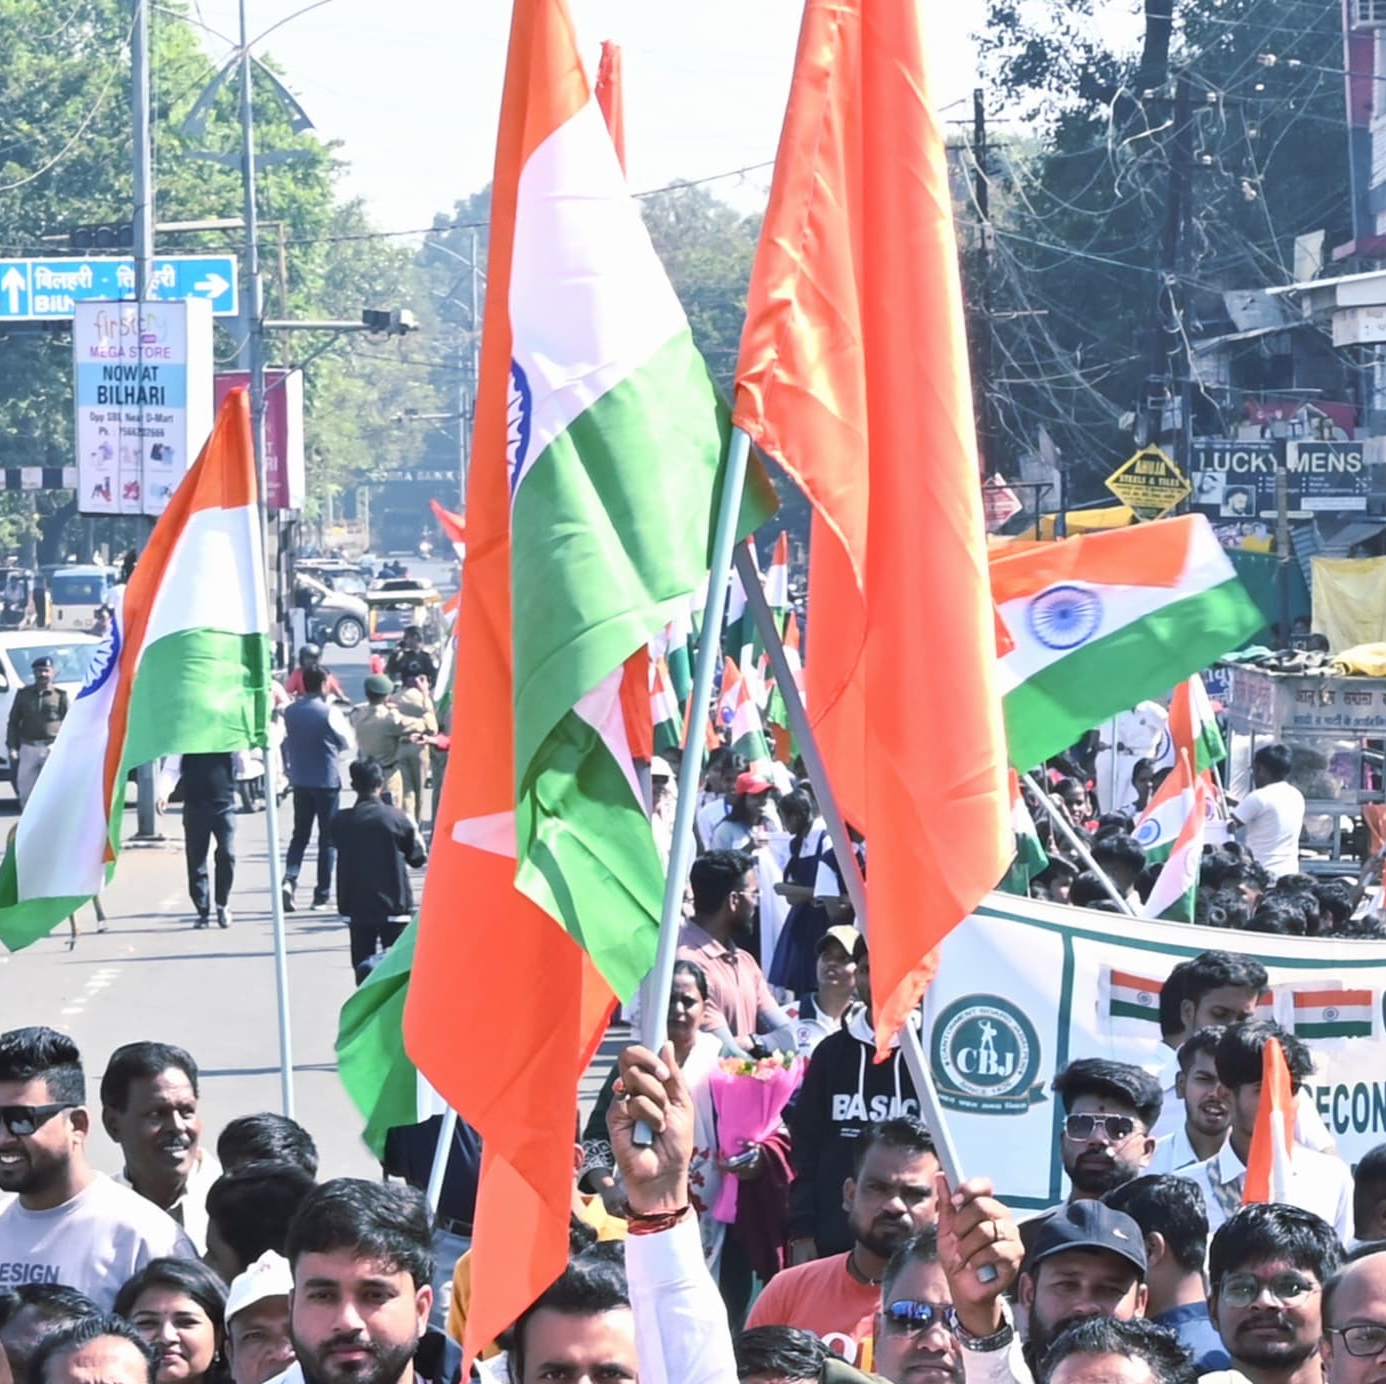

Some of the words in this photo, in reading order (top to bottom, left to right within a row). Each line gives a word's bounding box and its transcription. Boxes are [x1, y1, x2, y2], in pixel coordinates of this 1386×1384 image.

[90, 346, 125, 358] MEGA
[129, 346, 171, 359] STORE
[103, 366, 138, 381] NOW
[141, 367, 159, 381] AT
[97, 385, 165, 406] BILHARI
[1290, 453, 1361, 473] MENS
[956, 1047, 1014, 1077] CBJ
